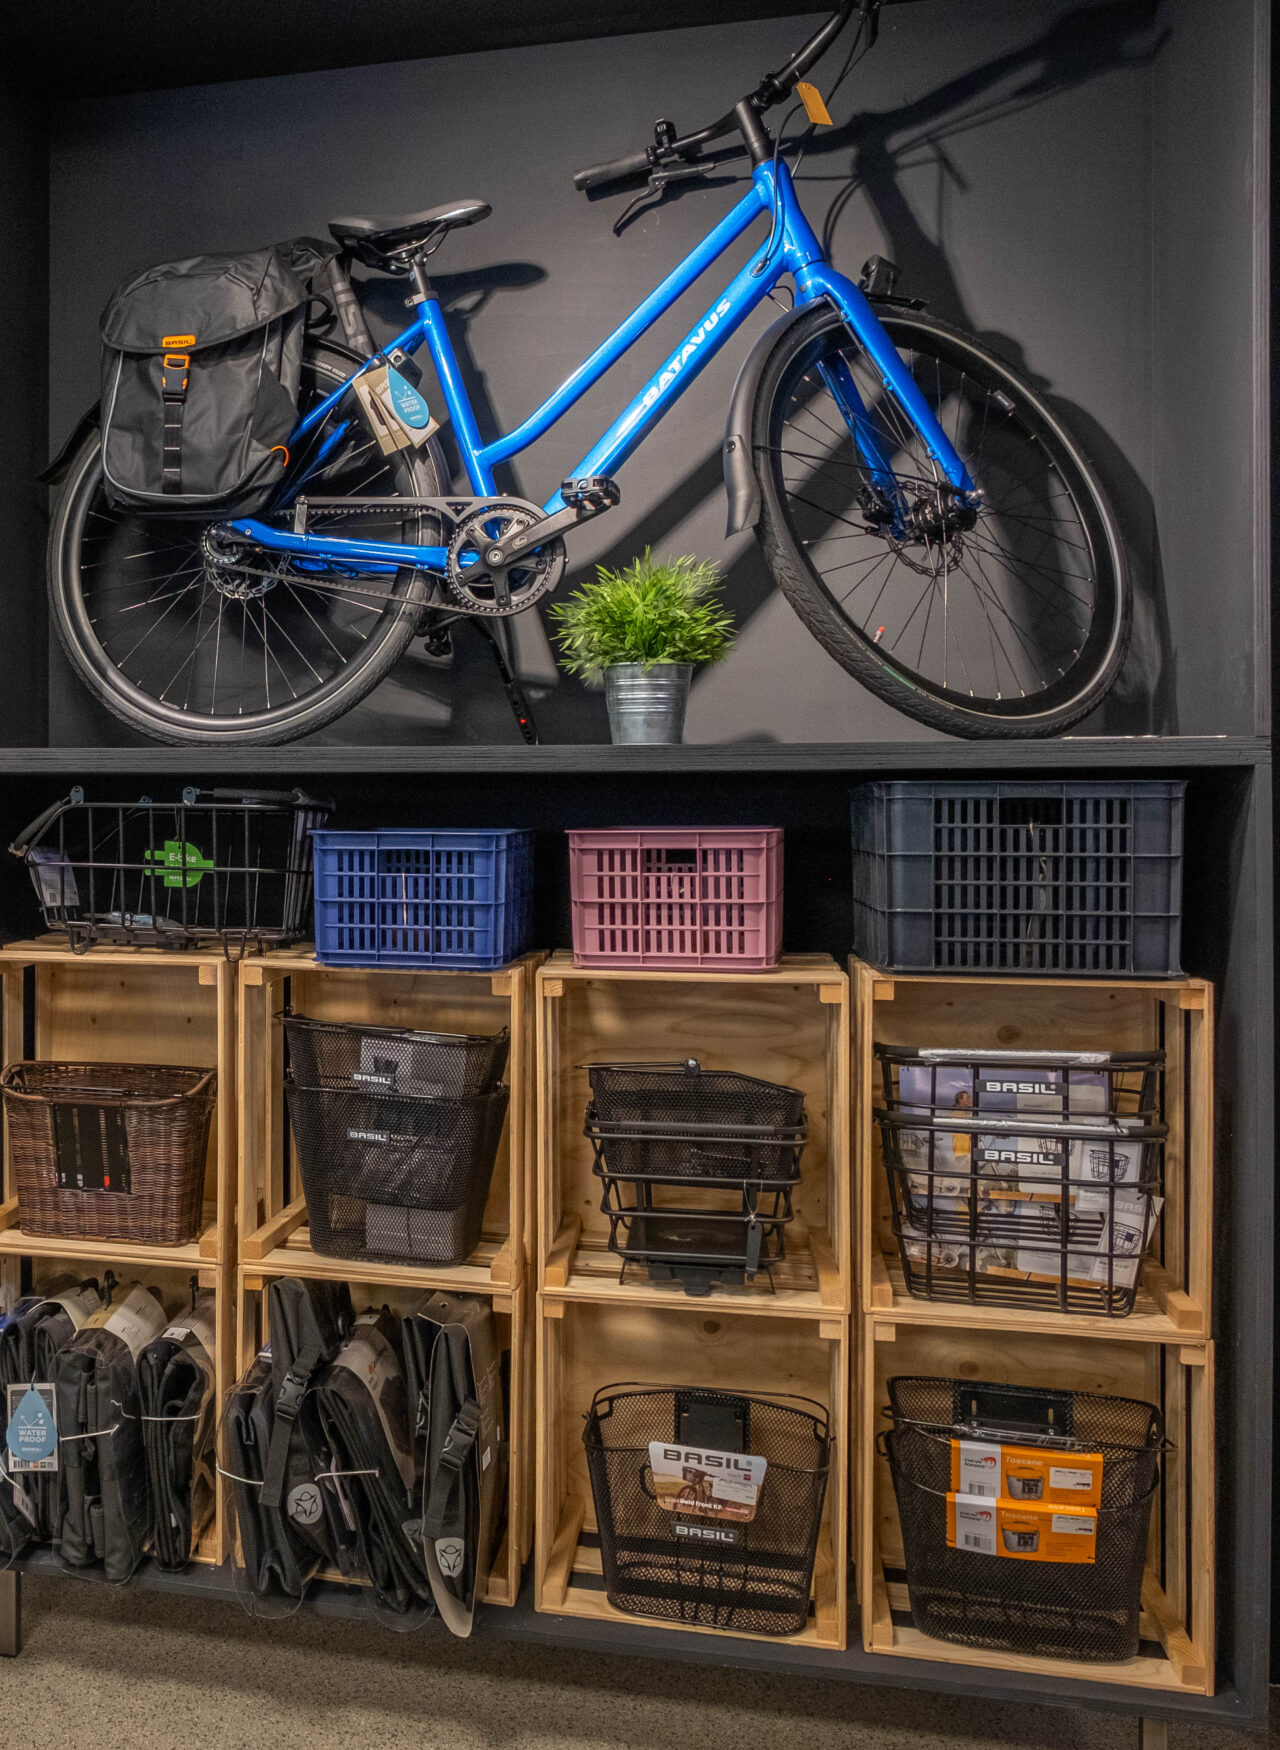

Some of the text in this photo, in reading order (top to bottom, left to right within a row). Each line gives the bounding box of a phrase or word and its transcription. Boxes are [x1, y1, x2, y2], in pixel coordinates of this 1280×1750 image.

[642, 298, 731, 404] BATAVUS
[169, 852, 197, 863] E-bke
[353, 1073, 391, 1084] BASIL
[986, 1082, 1056, 1094] BASIL
[349, 1131, 387, 1142] BASIL
[984, 1150, 1054, 1164] BASIL
[663, 1448, 752, 1472] BASIL
[1005, 1456, 1044, 1466] Toscane
[1000, 1511, 1039, 1521] Toscane
[675, 1526, 734, 1542] BASIL
